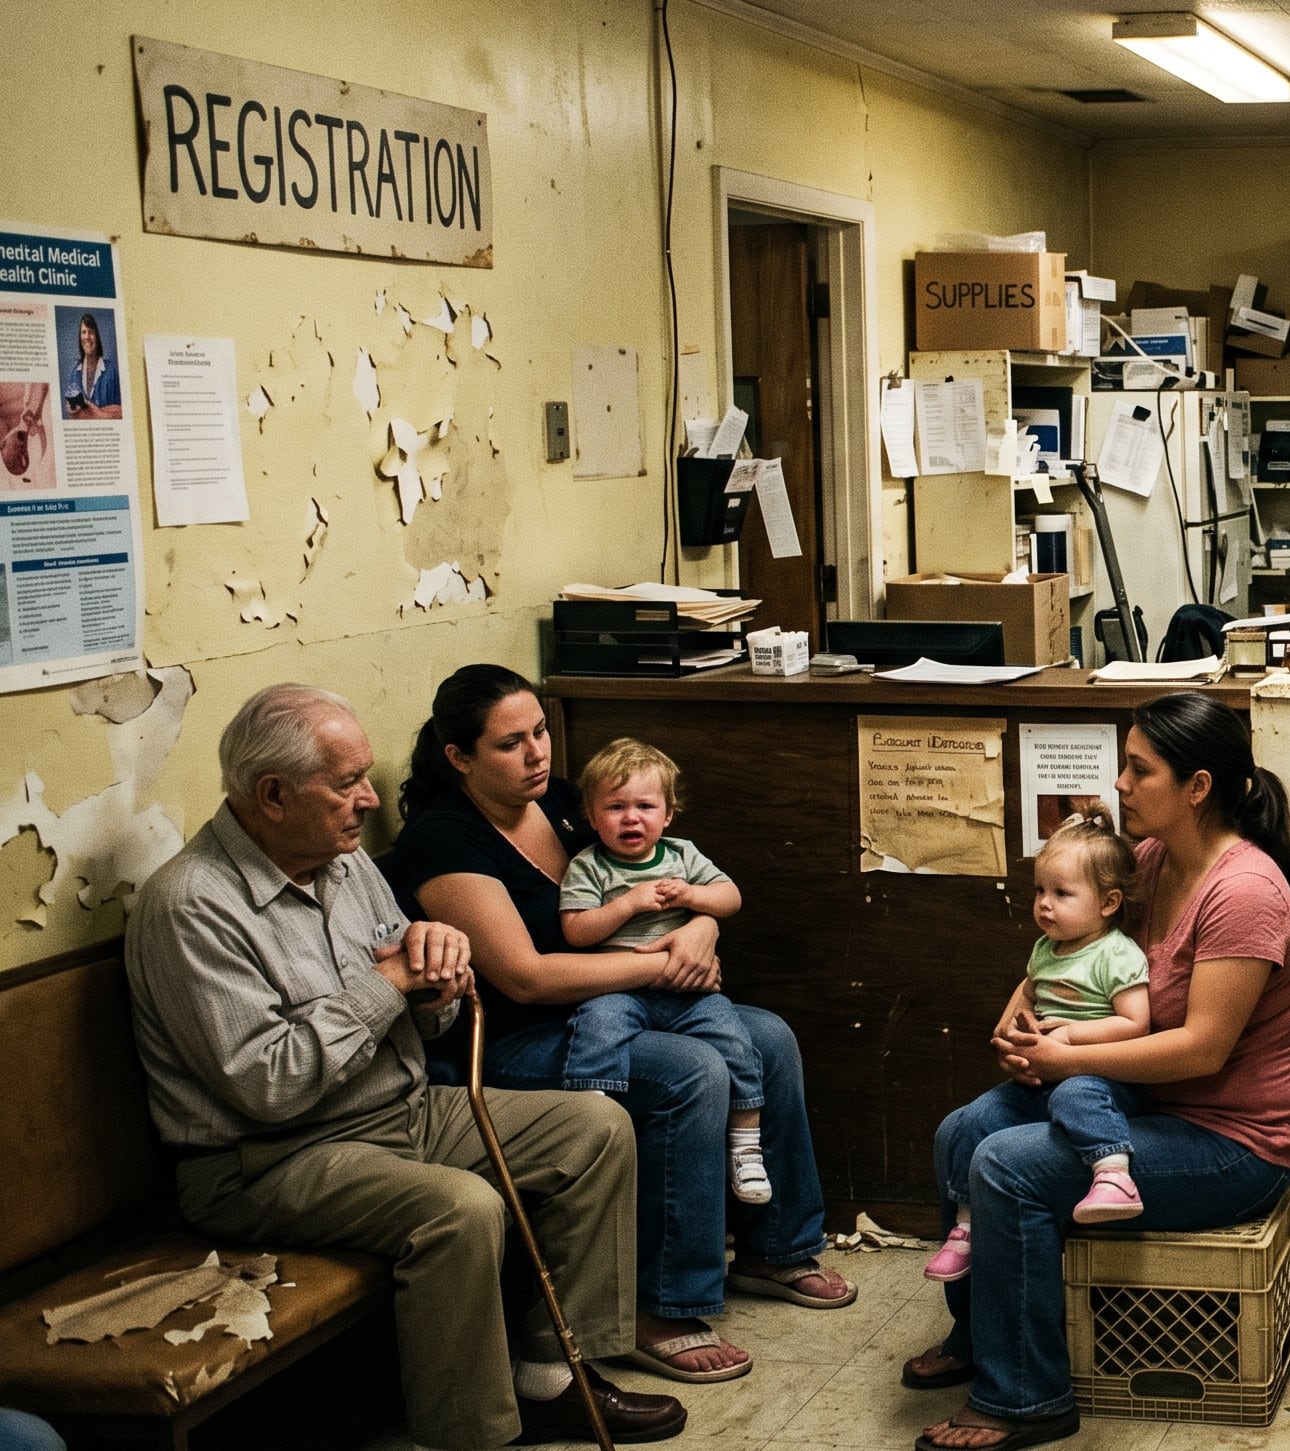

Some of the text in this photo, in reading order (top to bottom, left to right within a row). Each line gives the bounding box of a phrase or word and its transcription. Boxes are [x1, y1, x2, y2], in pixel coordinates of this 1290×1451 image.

[163, 84, 481, 232] REGISTRATION
[48, 247, 101, 267] Medical
[39, 267, 78, 287] Clinic
[925, 281, 1036, 310] SUPPLIES
